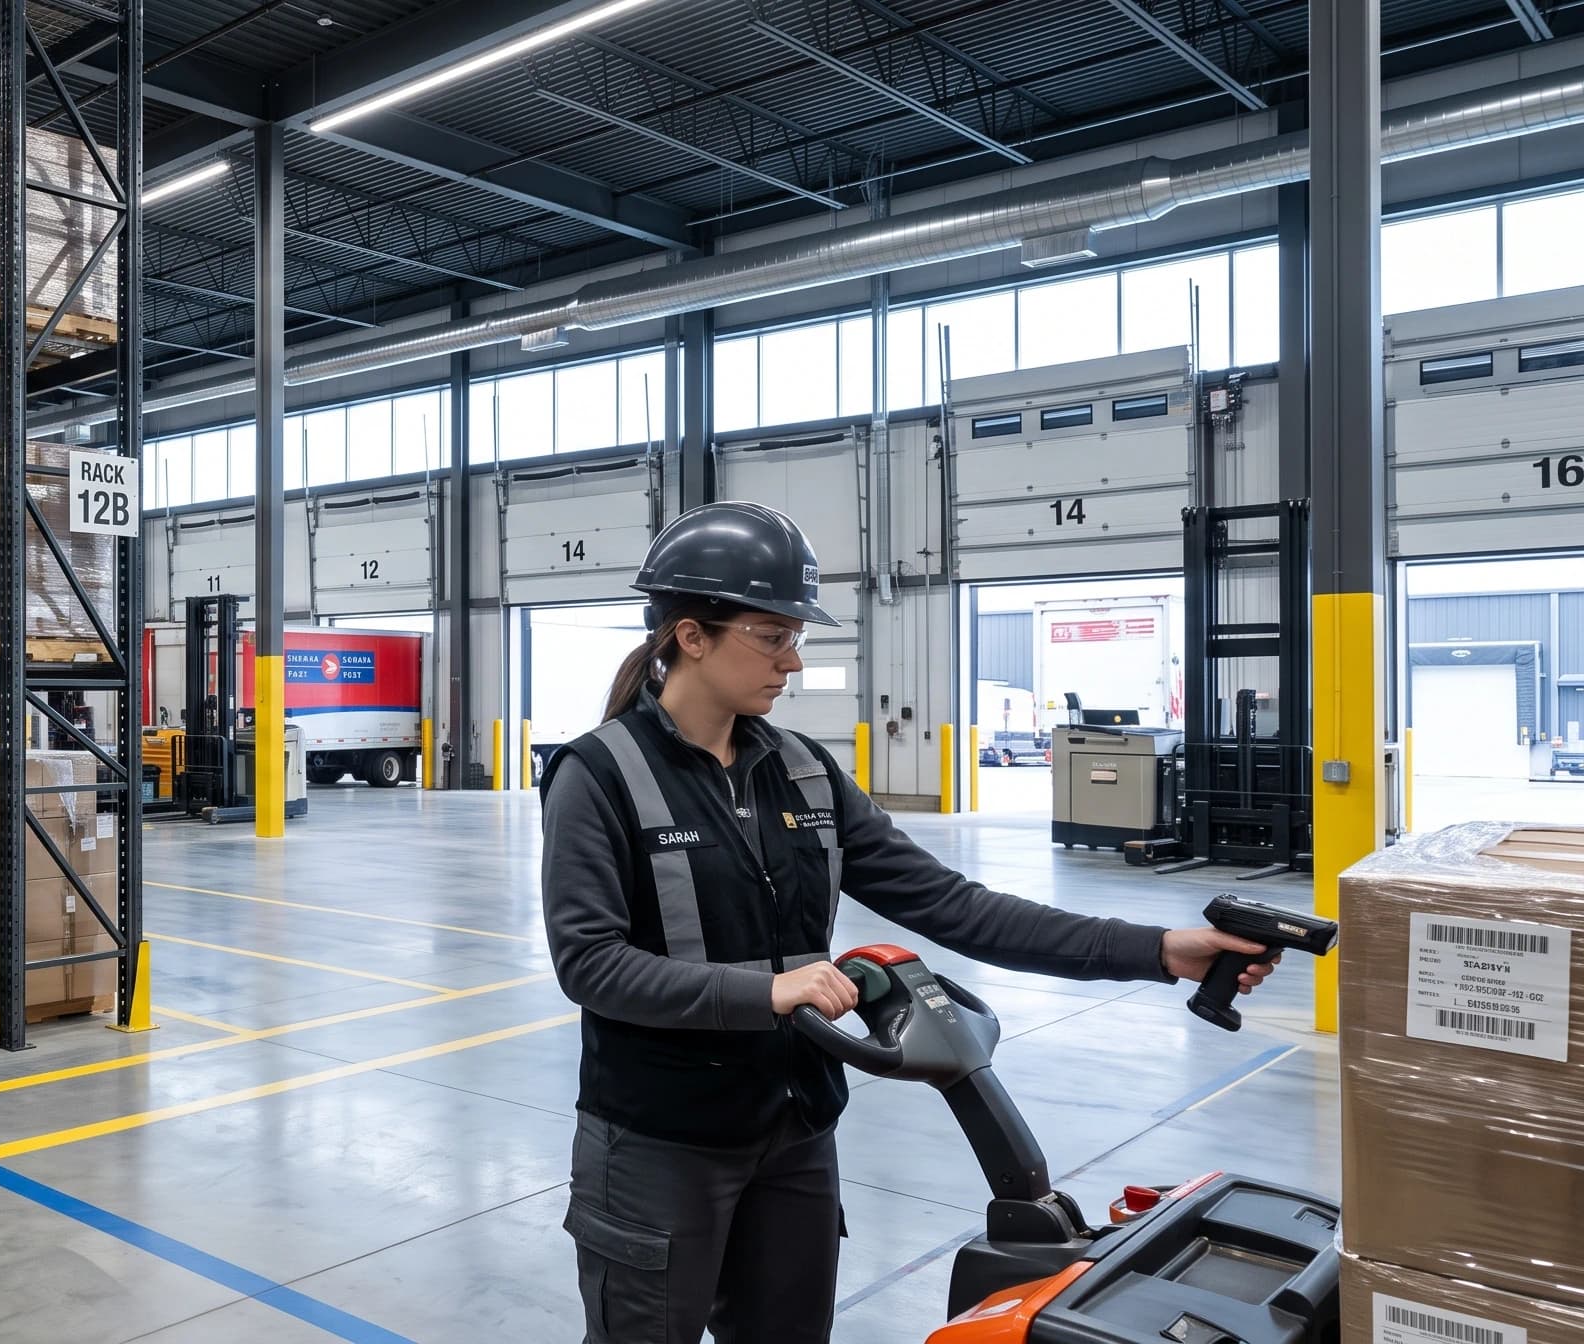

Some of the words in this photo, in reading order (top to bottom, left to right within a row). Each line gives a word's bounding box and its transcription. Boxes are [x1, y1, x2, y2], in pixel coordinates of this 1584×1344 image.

[81, 461, 125, 485] RACK
[1532, 455, 1584, 488] 16
[77, 489, 130, 526] 12B
[1050, 498, 1086, 526] 14
[562, 539, 586, 562] 14
[360, 559, 379, 580] 12
[207, 575, 220, 593] 11
[658, 831, 700, 845] SARAH
